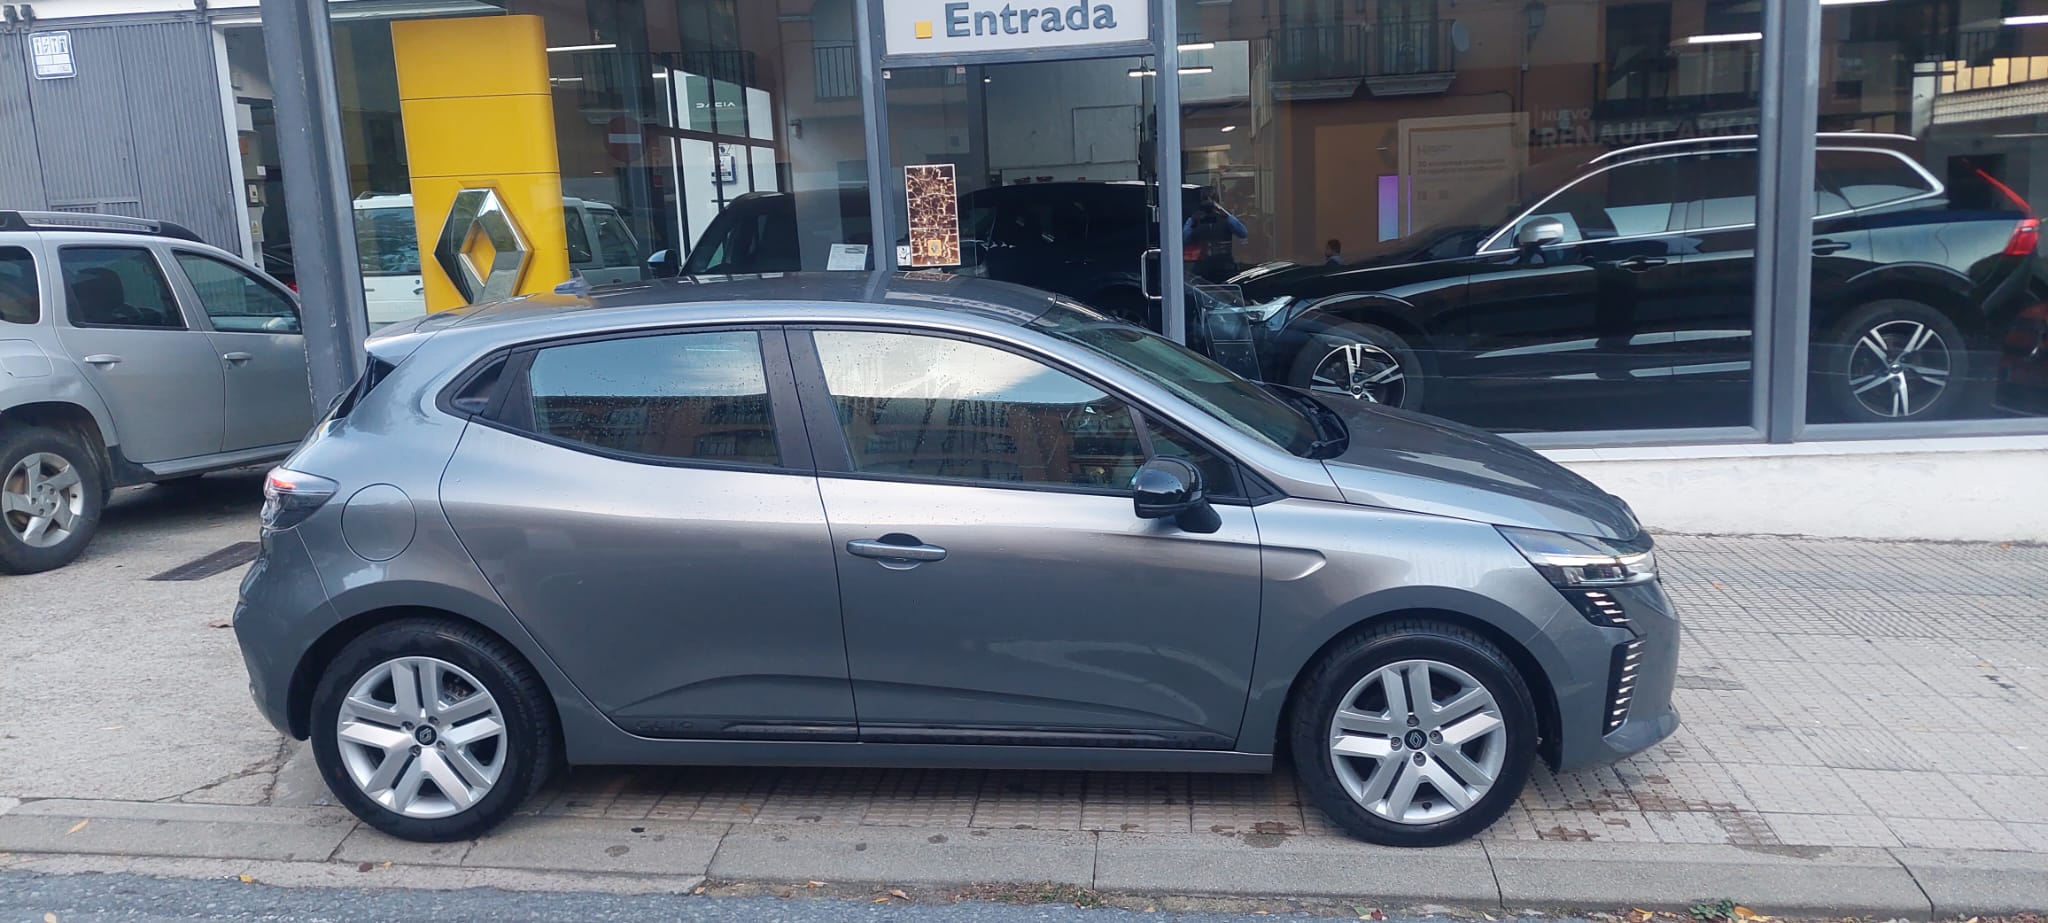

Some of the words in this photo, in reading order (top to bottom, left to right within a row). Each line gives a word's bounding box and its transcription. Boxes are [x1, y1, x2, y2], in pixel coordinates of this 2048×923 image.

[944, 0, 1117, 37] Entrada
[1542, 108, 1592, 121] NUEVO
[1541, 121, 1667, 148] RENAULT
[635, 719, 694, 730] CLIO
